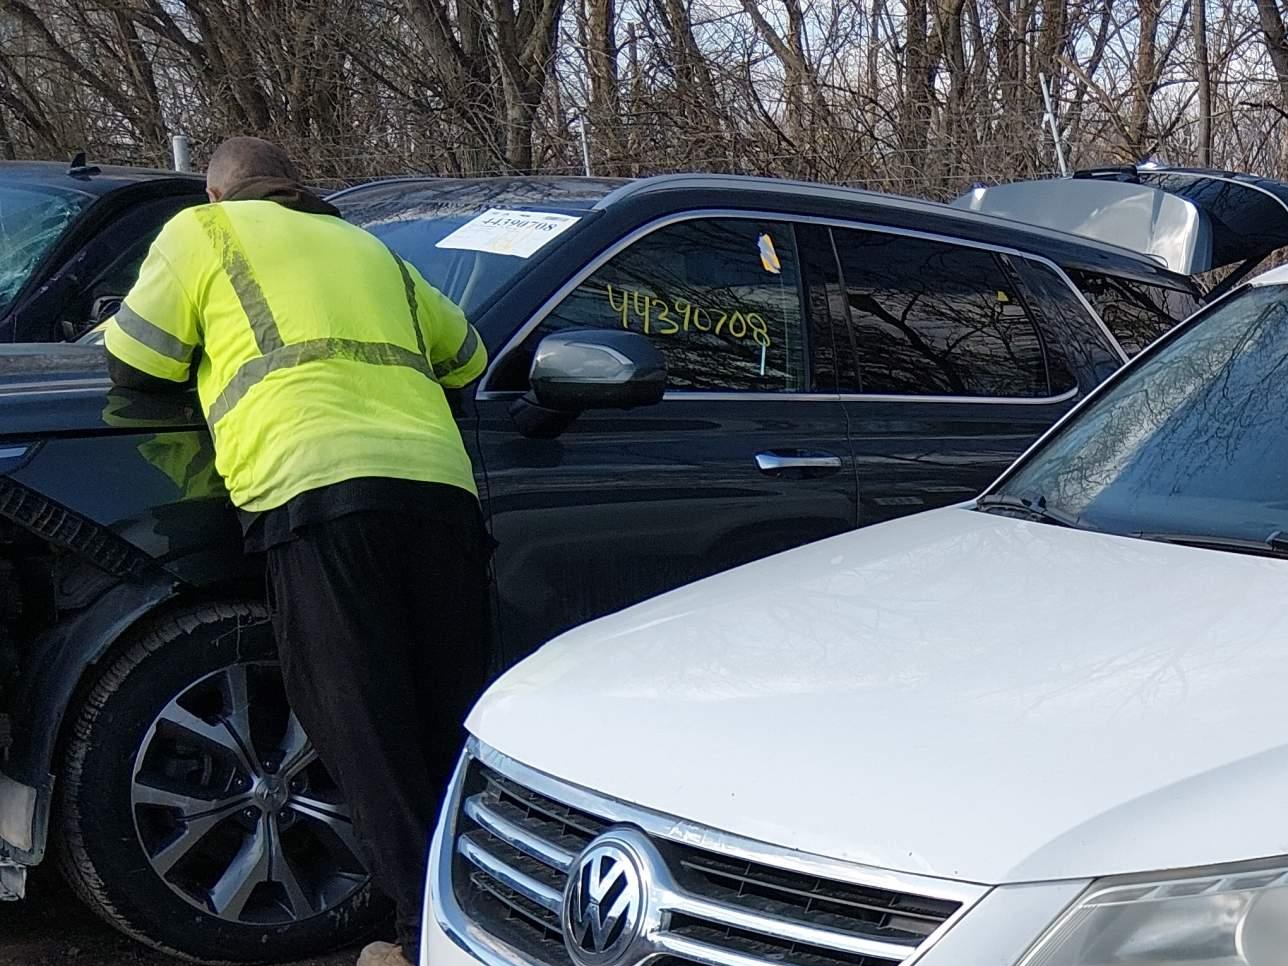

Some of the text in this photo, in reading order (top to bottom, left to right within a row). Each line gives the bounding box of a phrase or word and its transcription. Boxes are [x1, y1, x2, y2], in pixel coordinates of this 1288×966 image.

[483, 217, 558, 232] 44390708
[607, 283, 771, 348] 44390708
[567, 842, 643, 958] VW
